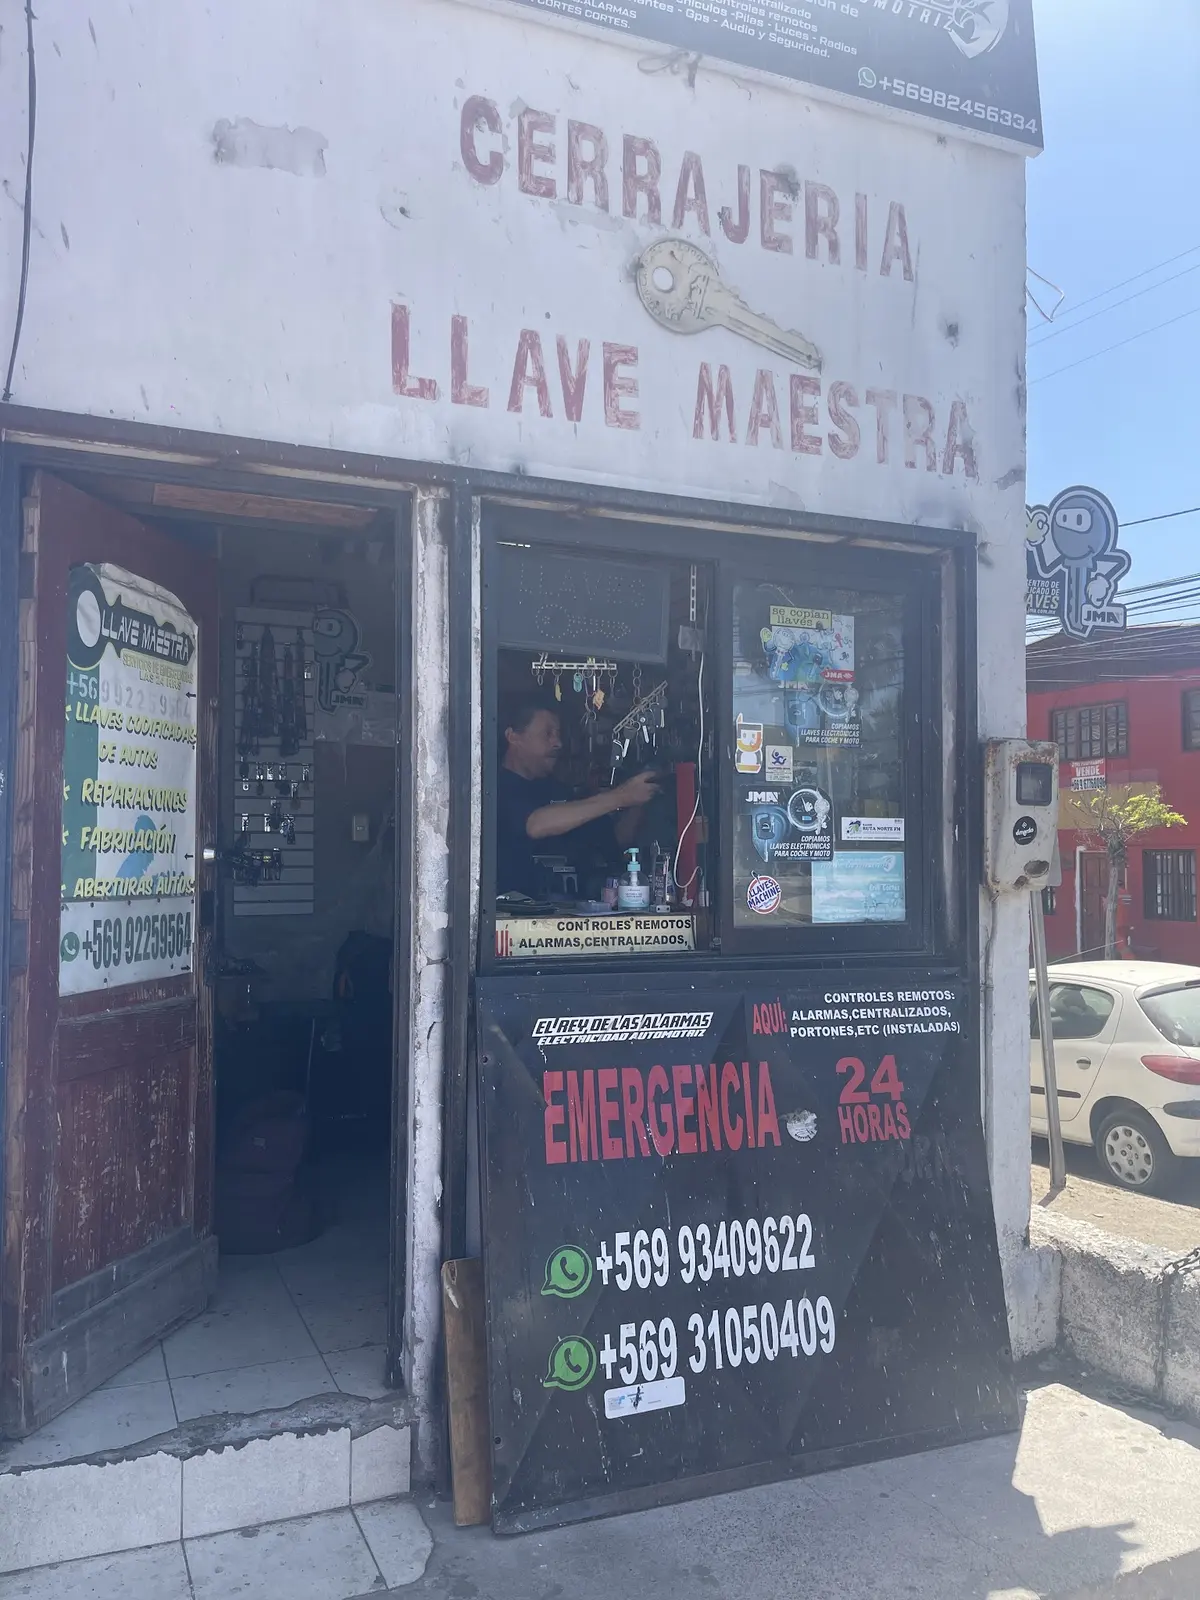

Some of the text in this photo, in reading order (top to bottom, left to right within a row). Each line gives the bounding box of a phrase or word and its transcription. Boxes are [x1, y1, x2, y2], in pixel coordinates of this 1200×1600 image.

[584, 9, 630, 29] CORTES.
[840, 3, 859, 18] de
[768, 11, 818, 32] remotos
[685, 9, 710, 24] Gps
[720, 18, 755, 36] Audio
[758, 31, 766, 40] y
[768, 32, 830, 58] Seguridad.
[774, 23, 809, 41] Luces
[819, 36, 857, 56] Radios
[878, 75, 1038, 134] +56982456334
[459, 95, 914, 282] CERRAJERIA
[390, 303, 980, 480] LLAVE MAESTRA
[1050, 580, 1060, 589] DE
[1051, 588, 1060, 597] DE
[771, 607, 830, 621] se copian
[776, 614, 813, 627] llaves
[1083, 610, 1120, 624] JMA
[101, 609, 189, 661] LLAVE MAESTRA
[75, 701, 197, 745] LLAVES CODIFICADAS
[831, 722, 860, 731] COPIAMOS
[98, 741, 158, 769] DE AUTOS
[1075, 765, 1101, 777] VENDE
[81, 778, 188, 813] REPARACIONES
[745, 791, 779, 802] JMA
[80, 824, 176, 854] FABRICACIÓN
[770, 842, 790, 850] LLAVES
[73, 872, 195, 898] ABERTURAS AUTOS
[749, 879, 774, 898] LLAVES
[748, 884, 780, 909] MACHINE
[557, 920, 632, 931] CONTROLES
[635, 919, 691, 930] REMOTOS
[82, 912, 192, 970] +569 92259564
[519, 934, 688, 950] ALARMAS,CENTRALIZADOS,
[824, 990, 956, 1003] CONTROLES REMOTOS:
[536, 1013, 713, 1035] EL REY DE LAS ALARMAS
[791, 1006, 952, 1022] ALARMAS,CENTRALIZADOS,
[536, 1028, 707, 1046] ELECTRICIDAD AUTOMOTRIZ
[790, 1021, 961, 1038] PORTONES,ETC (INSTALADAS)
[835, 1054, 905, 1105] 24
[543, 1061, 782, 1165] EMERGENCIA
[837, 1101, 911, 1144] HORAS
[596, 1213, 816, 1291] +569 93409622
[600, 1295, 836, 1385] +569 31050409
